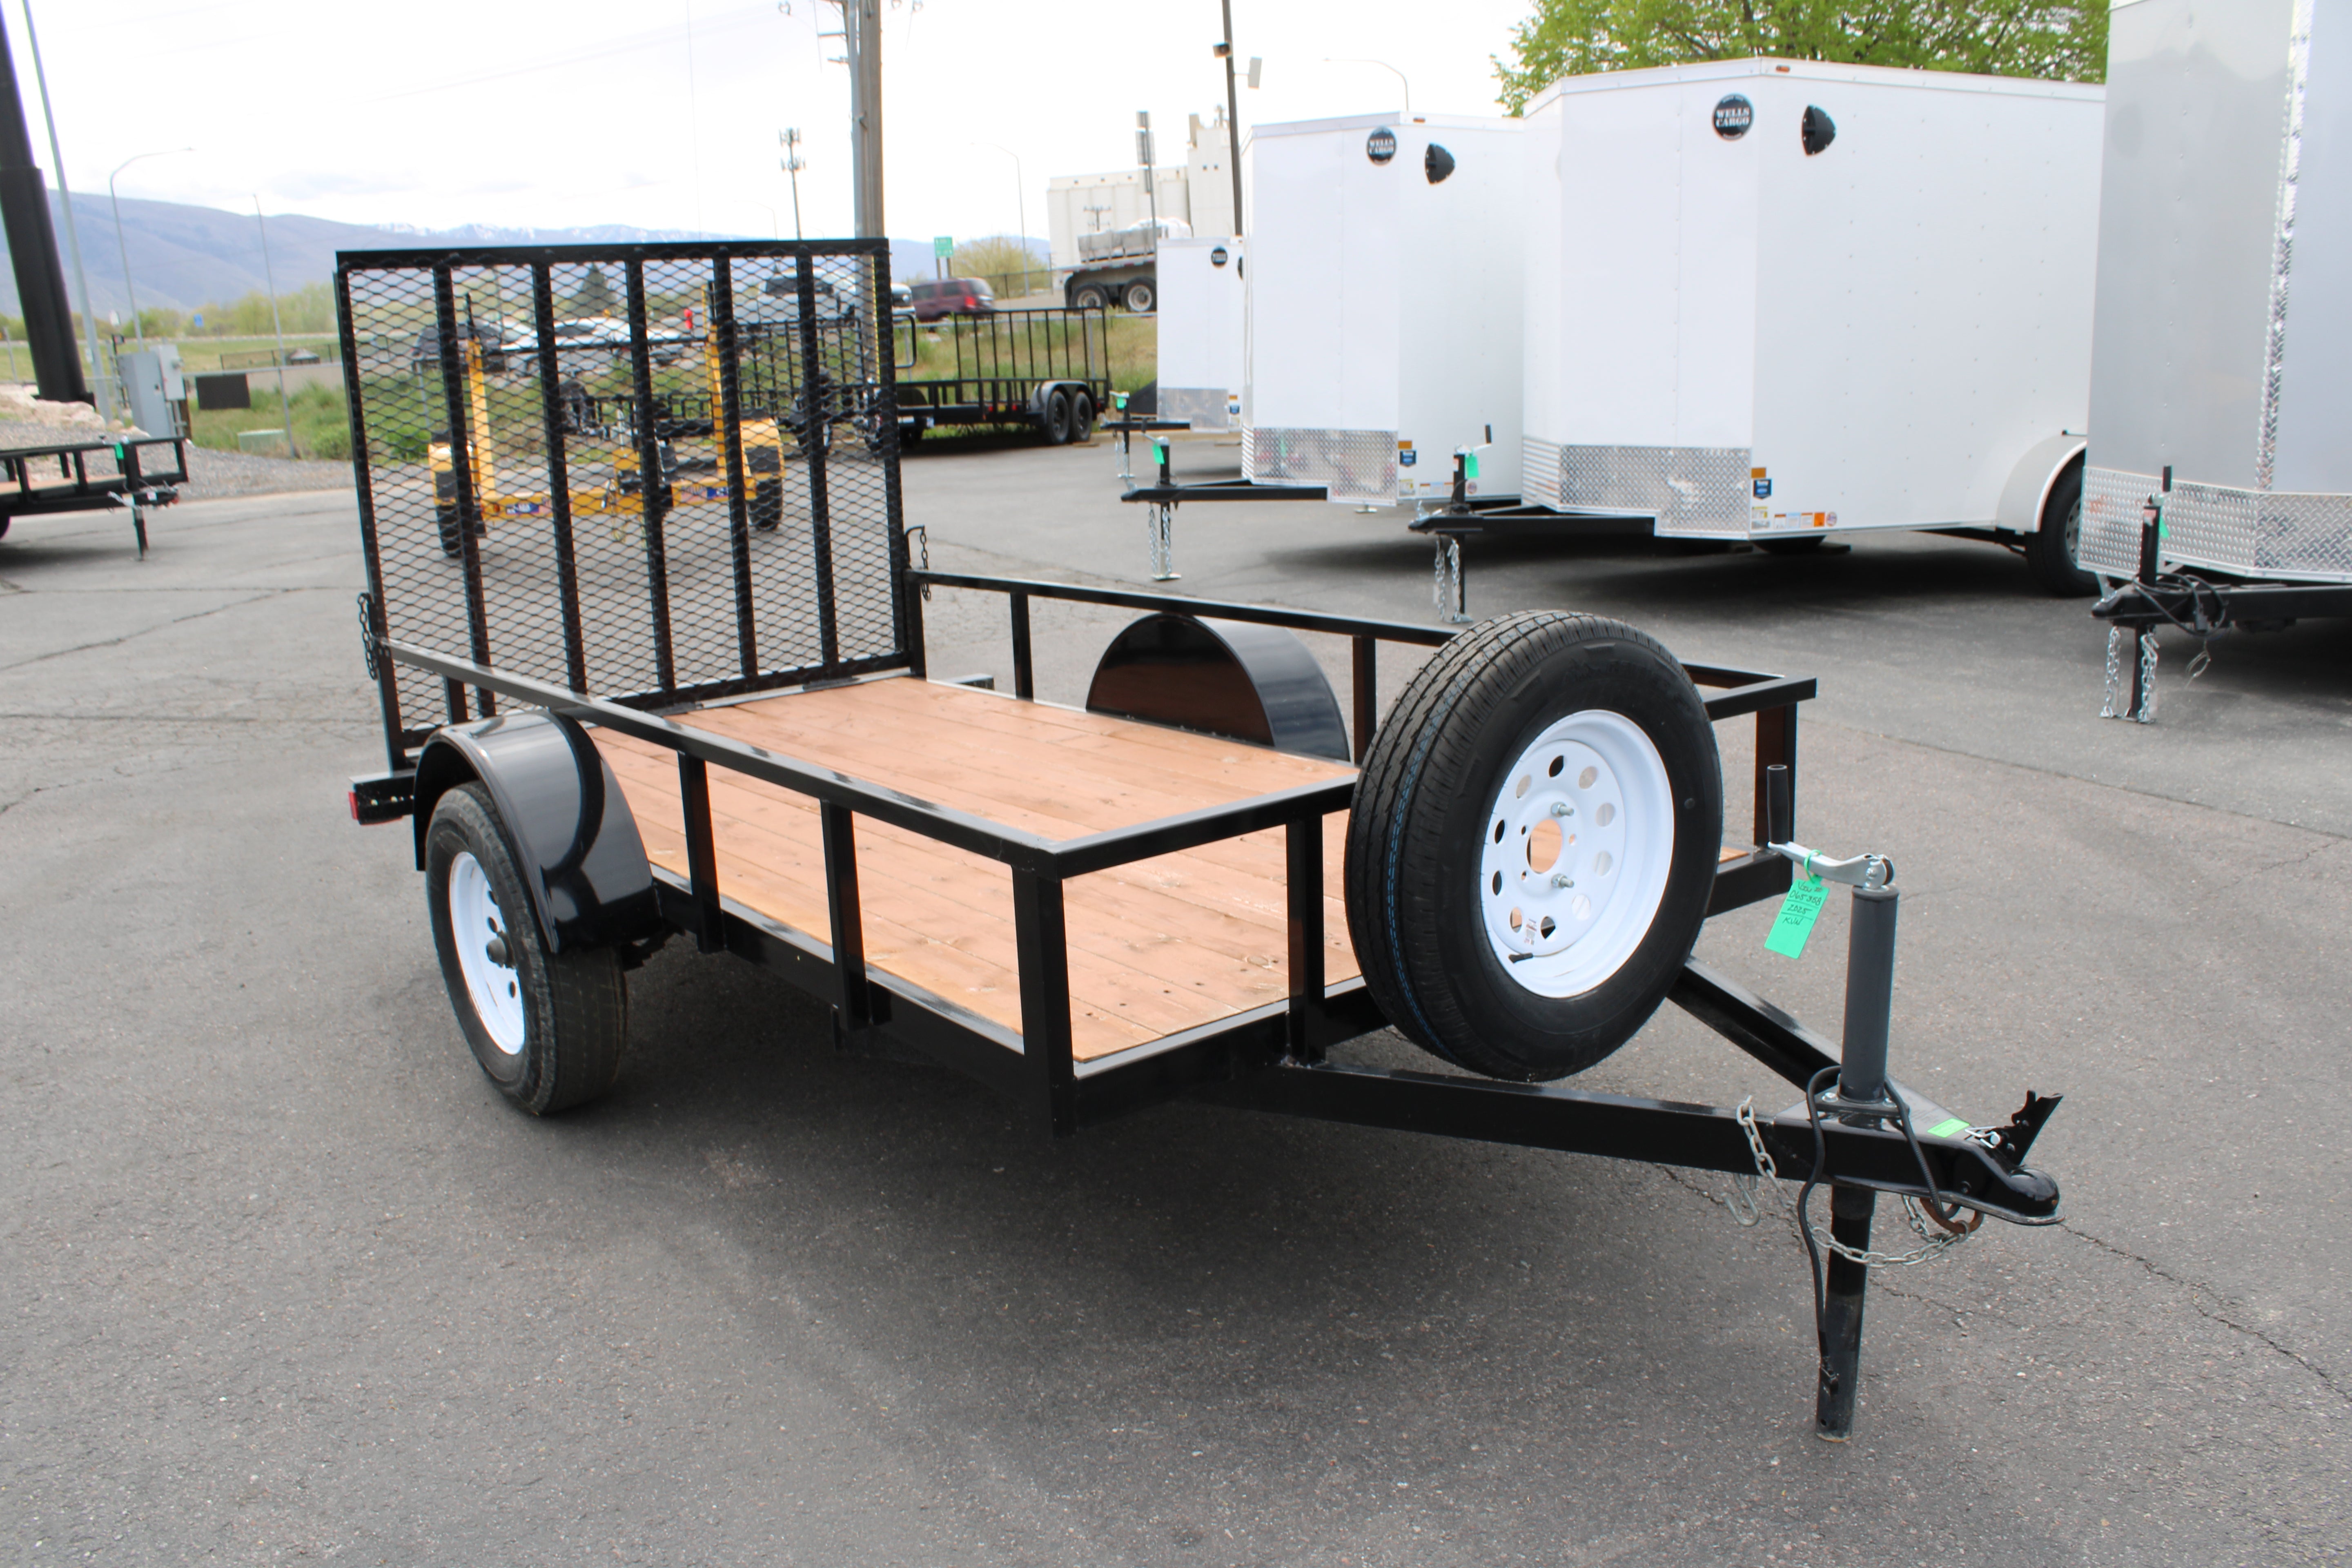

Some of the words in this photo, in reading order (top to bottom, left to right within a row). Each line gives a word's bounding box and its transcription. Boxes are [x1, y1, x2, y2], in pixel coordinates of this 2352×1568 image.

[1716, 106, 1750, 119] WELLS
[1715, 116, 1750, 128] CARGO
[1787, 904, 1813, 914] 2025
